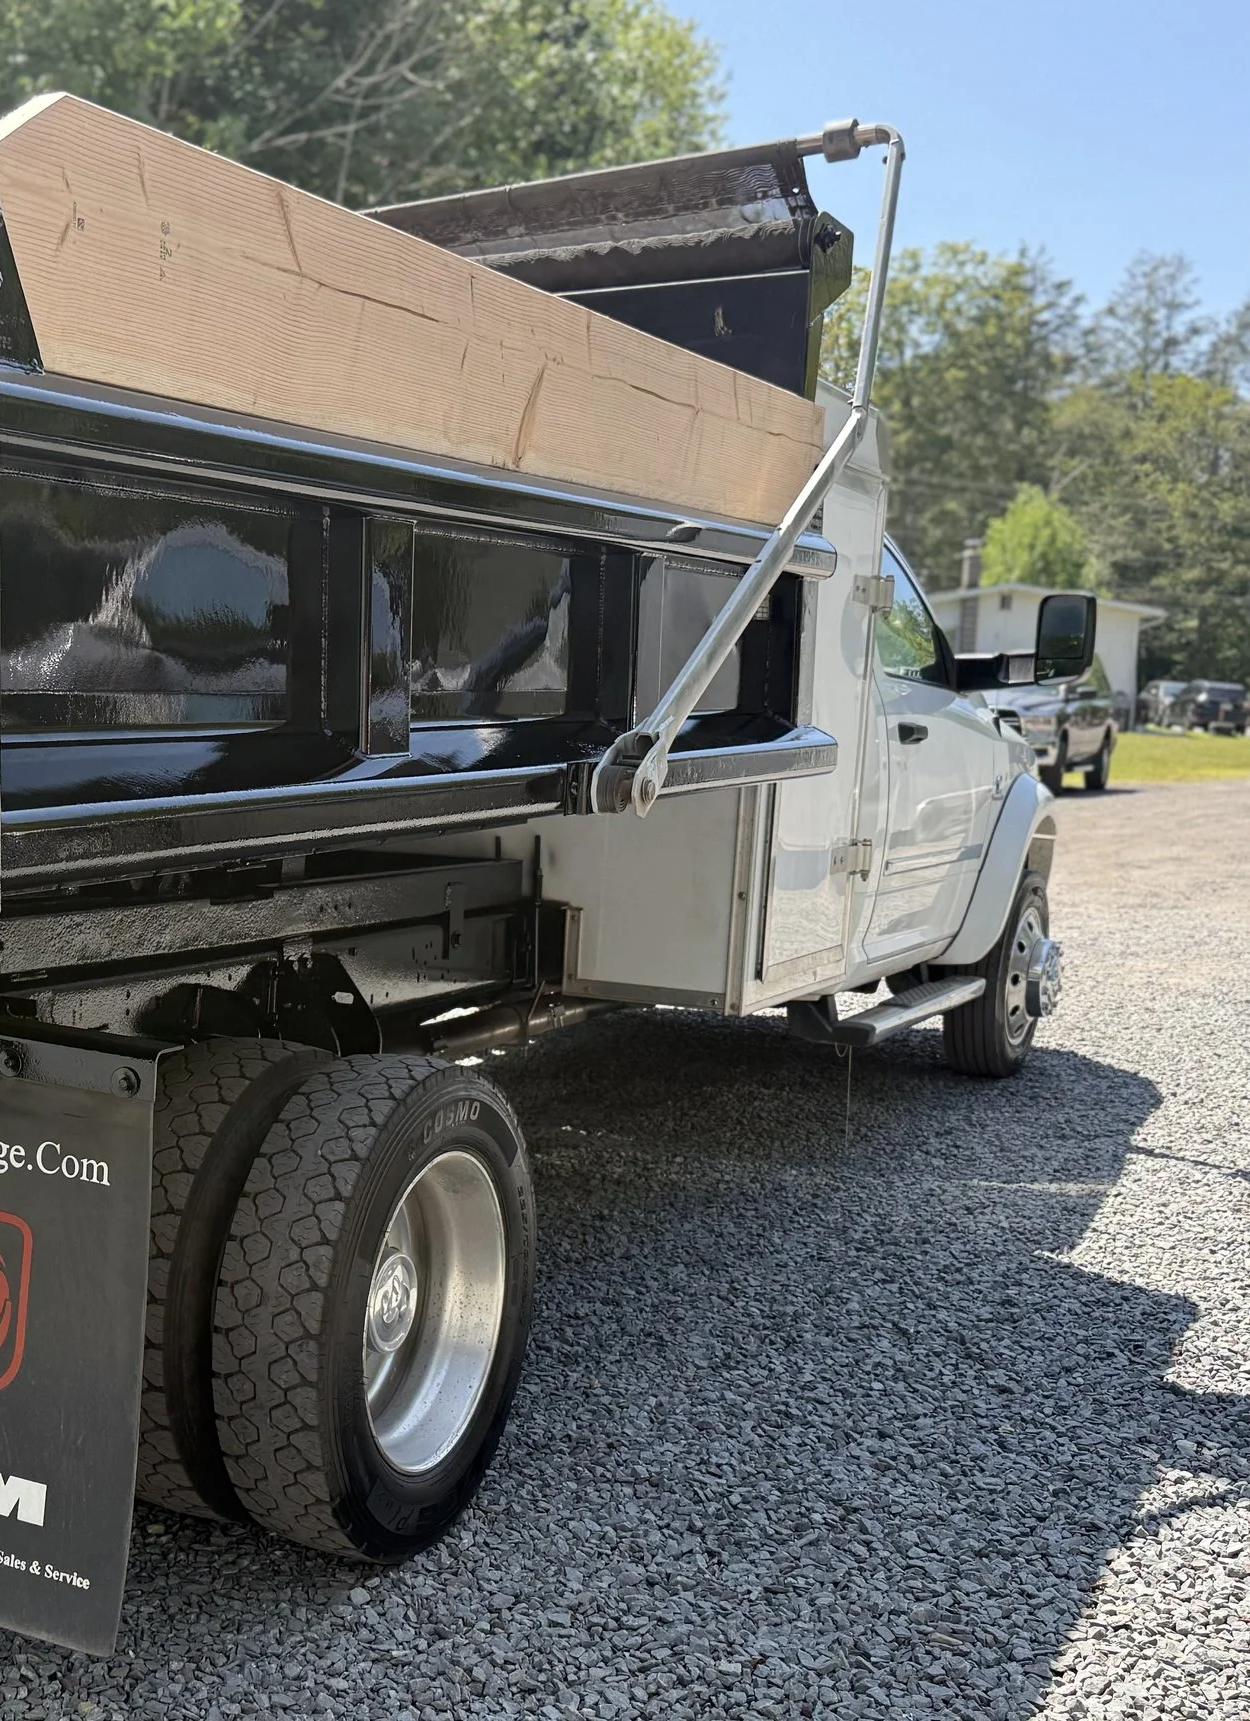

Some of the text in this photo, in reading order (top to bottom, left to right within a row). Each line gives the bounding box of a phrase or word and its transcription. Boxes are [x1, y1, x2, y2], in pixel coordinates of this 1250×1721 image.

[423, 1100, 481, 1144] COSMO
[28, 1560, 42, 1576] &
[44, 1563, 91, 1590] Service
